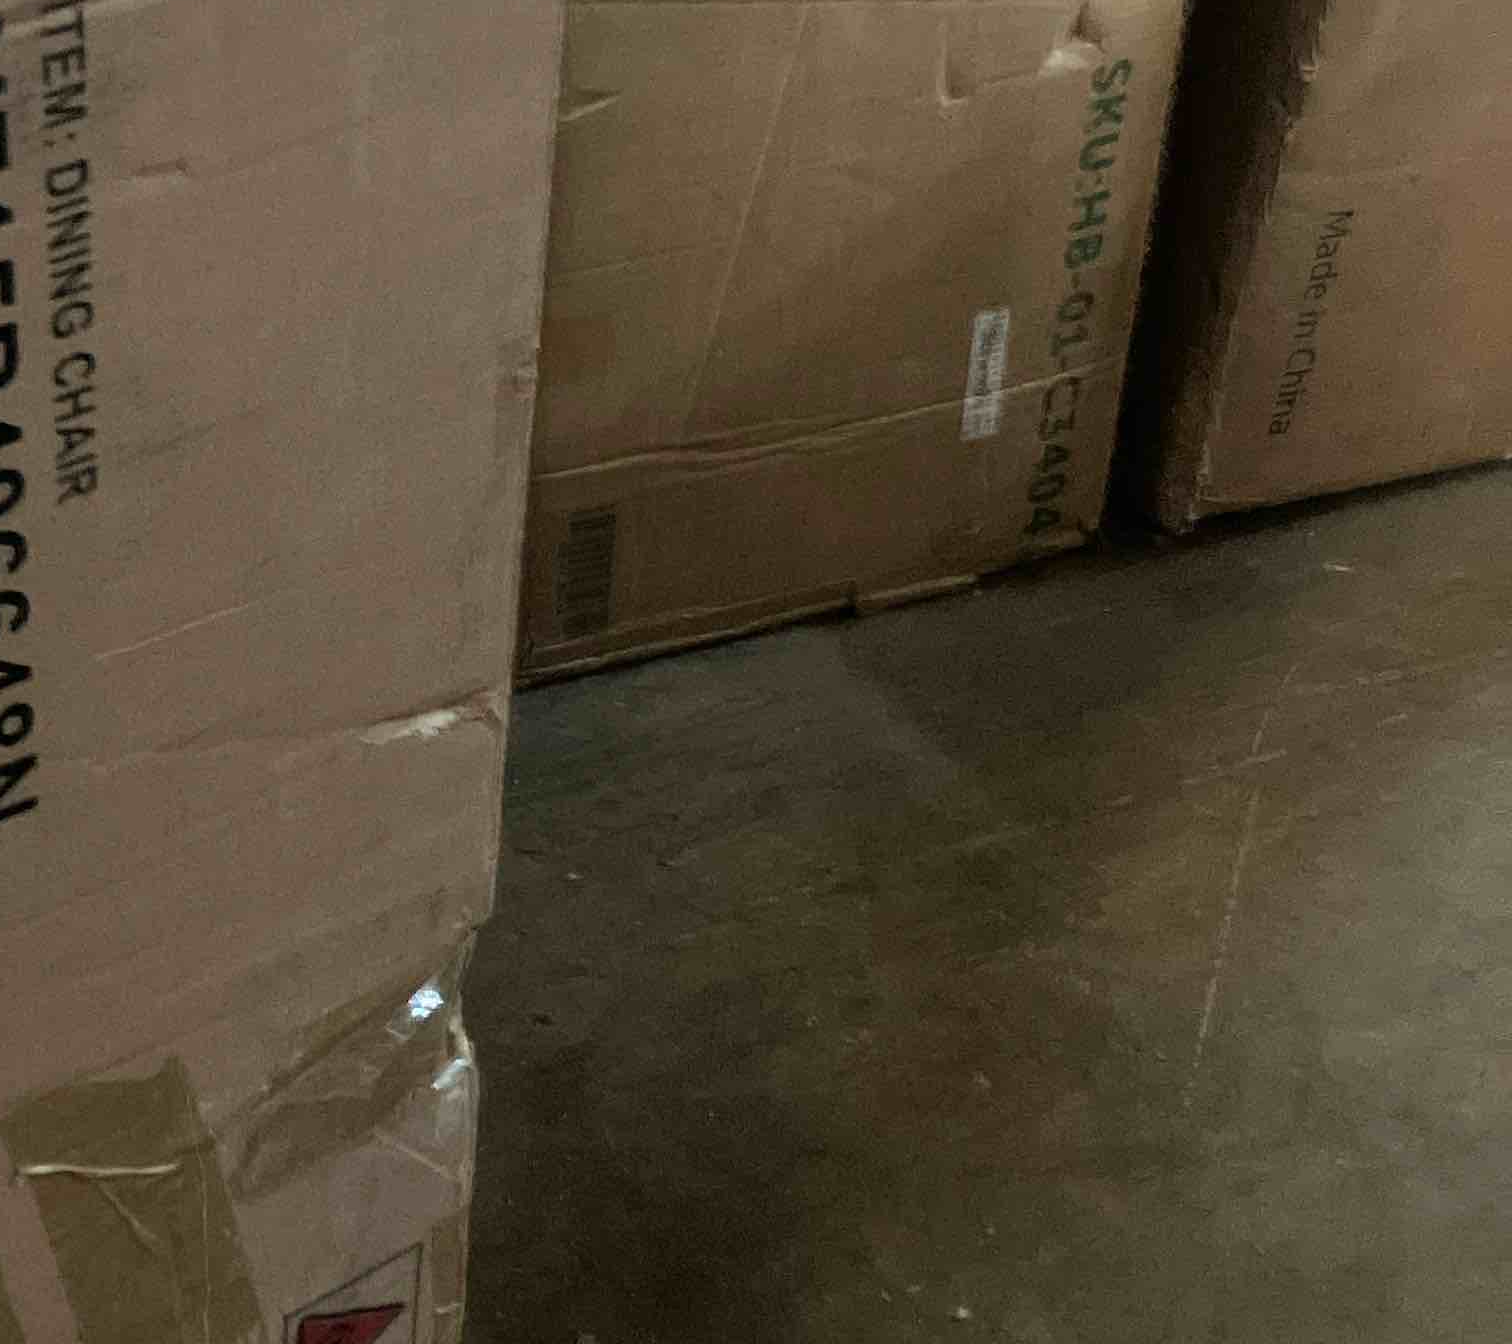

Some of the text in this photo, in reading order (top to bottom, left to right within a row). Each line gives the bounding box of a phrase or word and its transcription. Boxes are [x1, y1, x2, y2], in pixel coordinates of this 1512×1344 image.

[43, 158, 96, 340] DINING
[1267, 210, 1354, 436] Made in China
[51, 350, 99, 506] CHAIR
